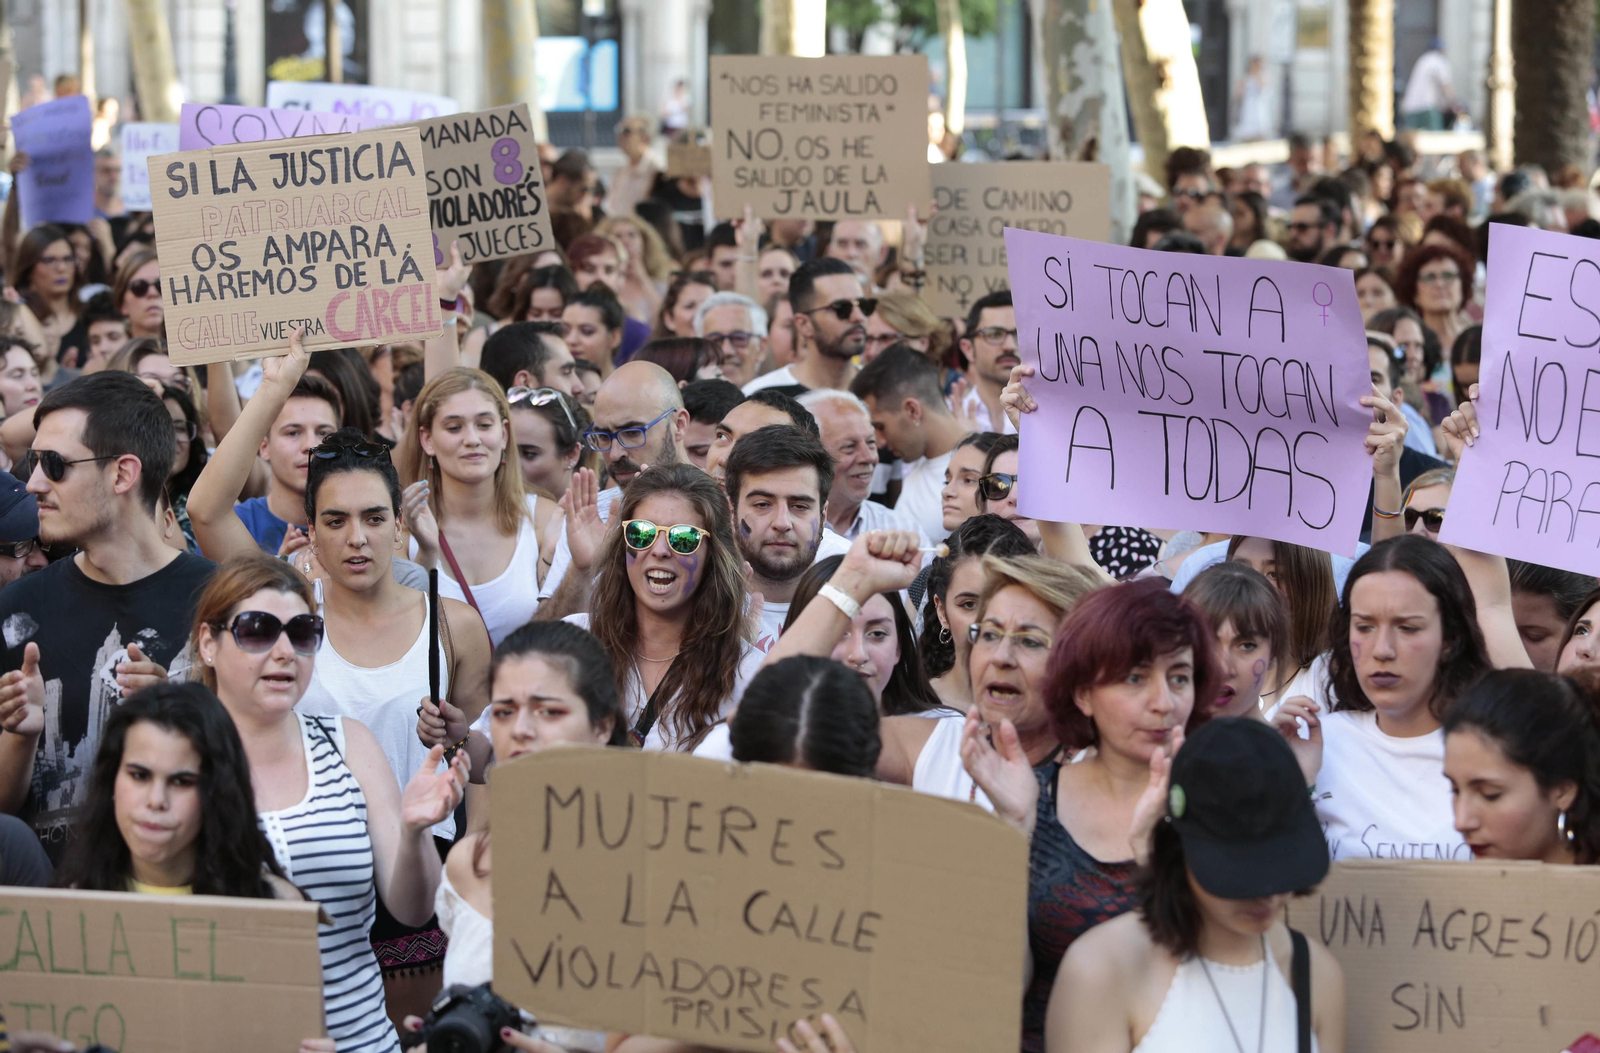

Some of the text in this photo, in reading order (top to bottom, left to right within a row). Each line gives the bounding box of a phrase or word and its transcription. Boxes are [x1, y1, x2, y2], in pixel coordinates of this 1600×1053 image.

[787, 75, 815, 95] HA
[818, 74, 899, 96] SALIDO
[420, 110, 528, 149] MANADA
[794, 136, 831, 161] OS
[842, 135, 875, 159] HE
[166, 161, 199, 199] SI
[209, 156, 257, 195] LA
[269, 141, 416, 189] JUSTICIA
[425, 164, 482, 196] SON
[734, 164, 889, 188] SALIDO DE LA
[201, 186, 421, 241] PATRIARCAL
[430, 180, 541, 230] VIOLADORES
[772, 189, 882, 214] JAULA
[934, 186, 1073, 213] DE CAMINO
[458, 222, 543, 261] JUECES
[932, 215, 984, 237] CASA
[192, 240, 241, 272] OS
[923, 242, 968, 266] SER
[169, 255, 424, 306] HAREMOS DE LA
[1094, 264, 1222, 337] TOCAN
[1248, 275, 1286, 343] A
[177, 311, 260, 350] CALLE
[1037, 327, 1340, 428] UNA NOS TOCAN
[1495, 350, 1568, 446] NO
[1065, 405, 1337, 530] A TODAS
[541, 783, 846, 871] MUJERES
[540, 869, 883, 953] A LA CALLE
[1319, 894, 1386, 948] UNA
[169, 914, 245, 983] EL
[836, 988, 869, 1023] A
